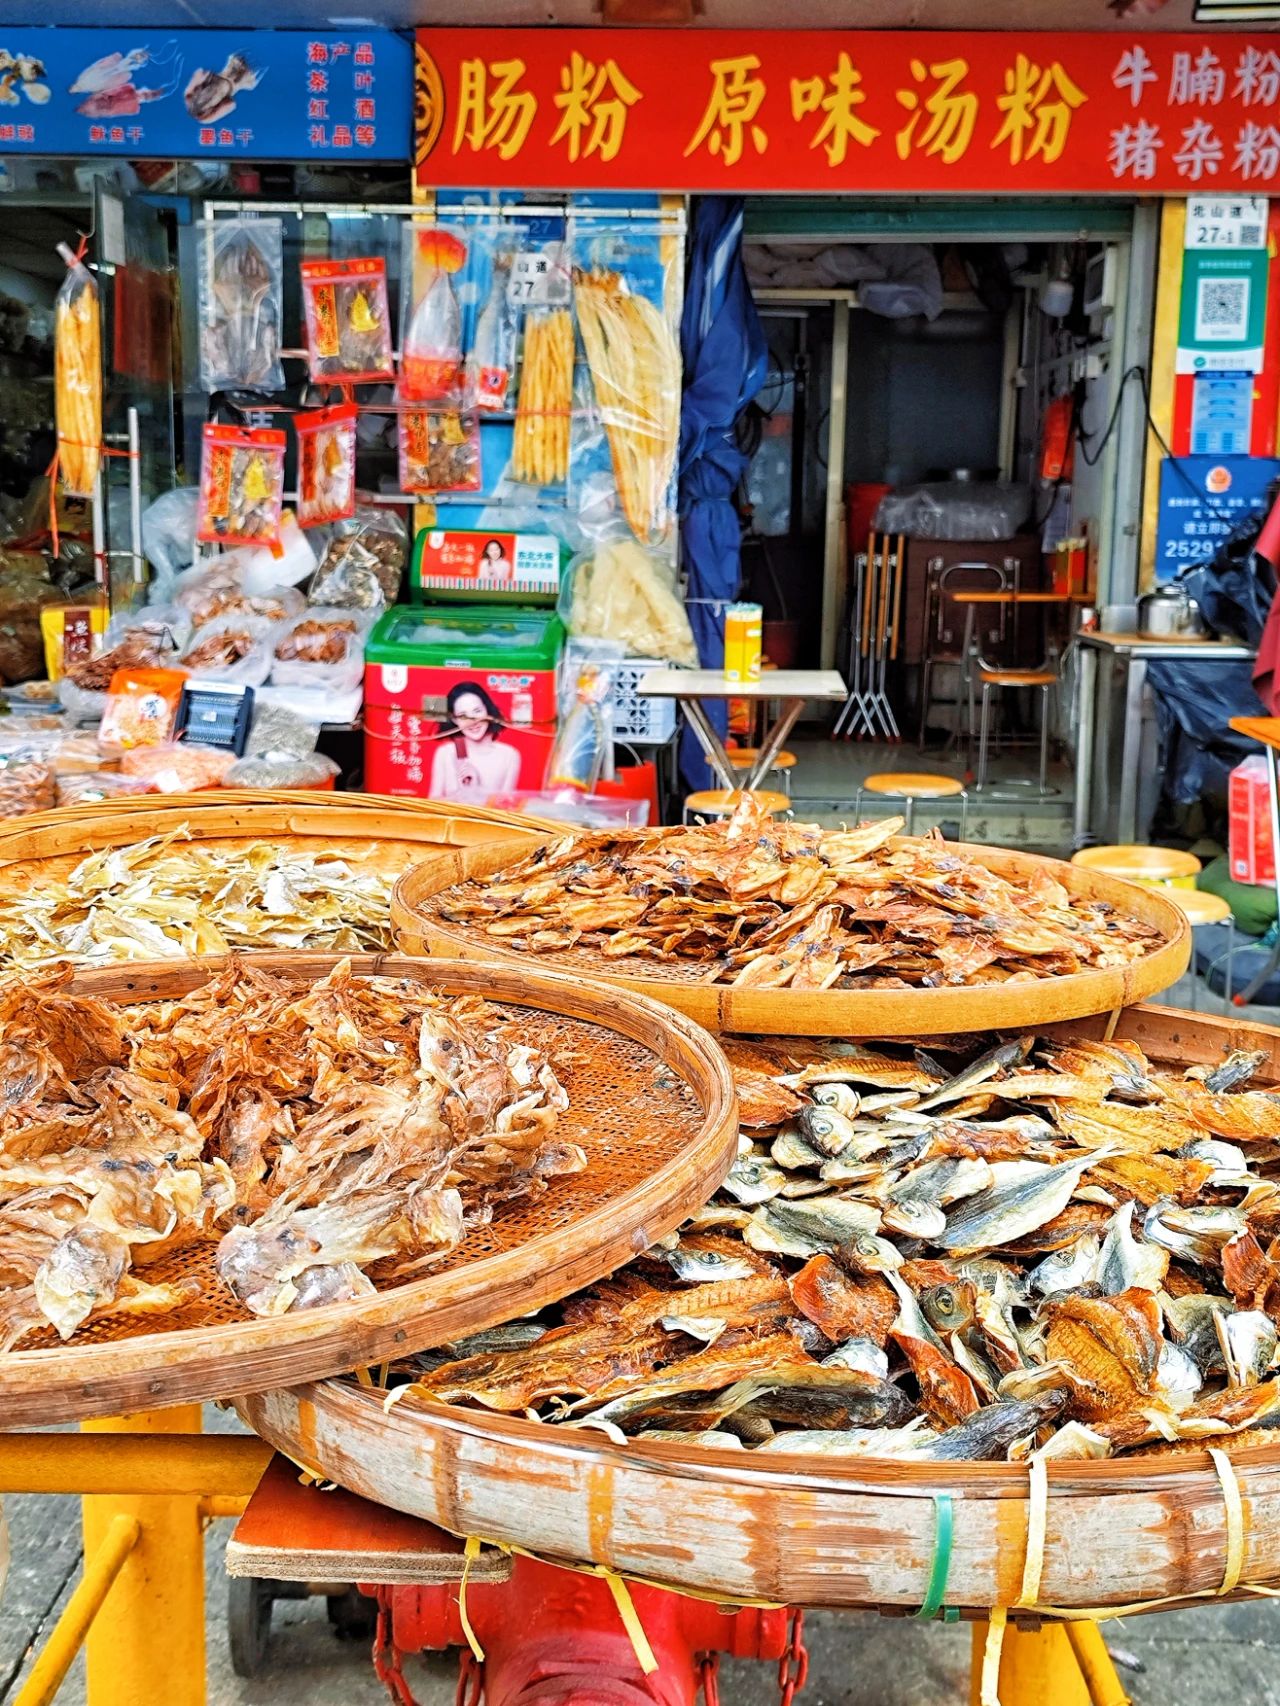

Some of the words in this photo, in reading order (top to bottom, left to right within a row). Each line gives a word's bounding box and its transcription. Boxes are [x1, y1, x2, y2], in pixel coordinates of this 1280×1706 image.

[306, 41, 375, 66] 海产品
[306, 69, 376, 94] 茶叶
[1111, 44, 1280, 107] 牛腩粉
[307, 97, 376, 120] 红酒
[452, 50, 643, 163] 肠粉
[683, 51, 1089, 167] 原味汤粉
[307, 124, 376, 148] 礼品等
[1107, 117, 1280, 181] 猪杂粉
[529, 219, 552, 235] 27
[512, 281, 535, 298] 27
[1165, 540, 1224, 558] 2529
